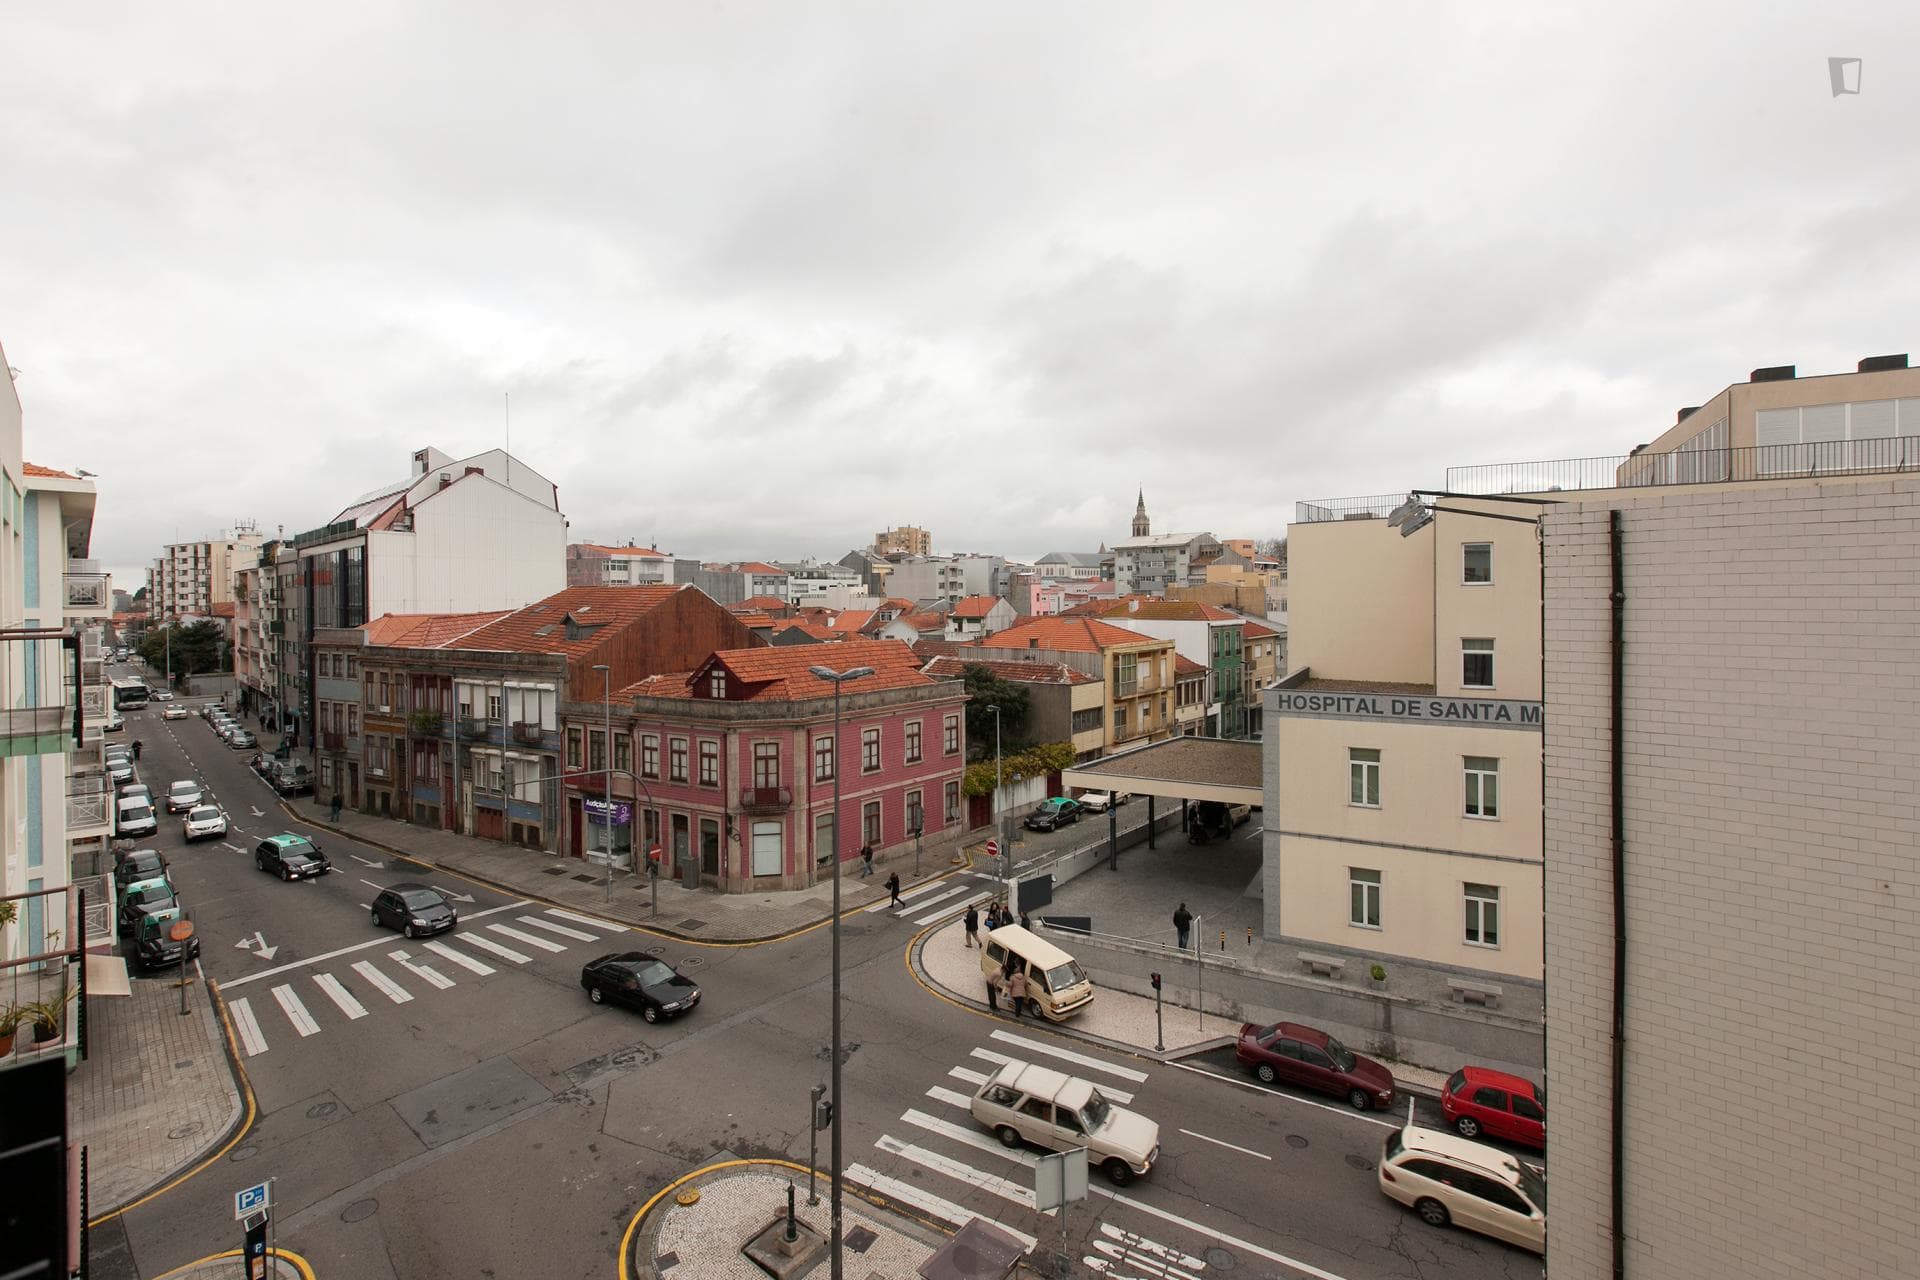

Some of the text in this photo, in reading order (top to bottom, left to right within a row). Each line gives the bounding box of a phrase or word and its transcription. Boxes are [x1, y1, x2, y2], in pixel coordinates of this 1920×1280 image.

[1278, 694, 1540, 723] HOSPITAL DE SANTA M
[242, 1192, 254, 1208] P
